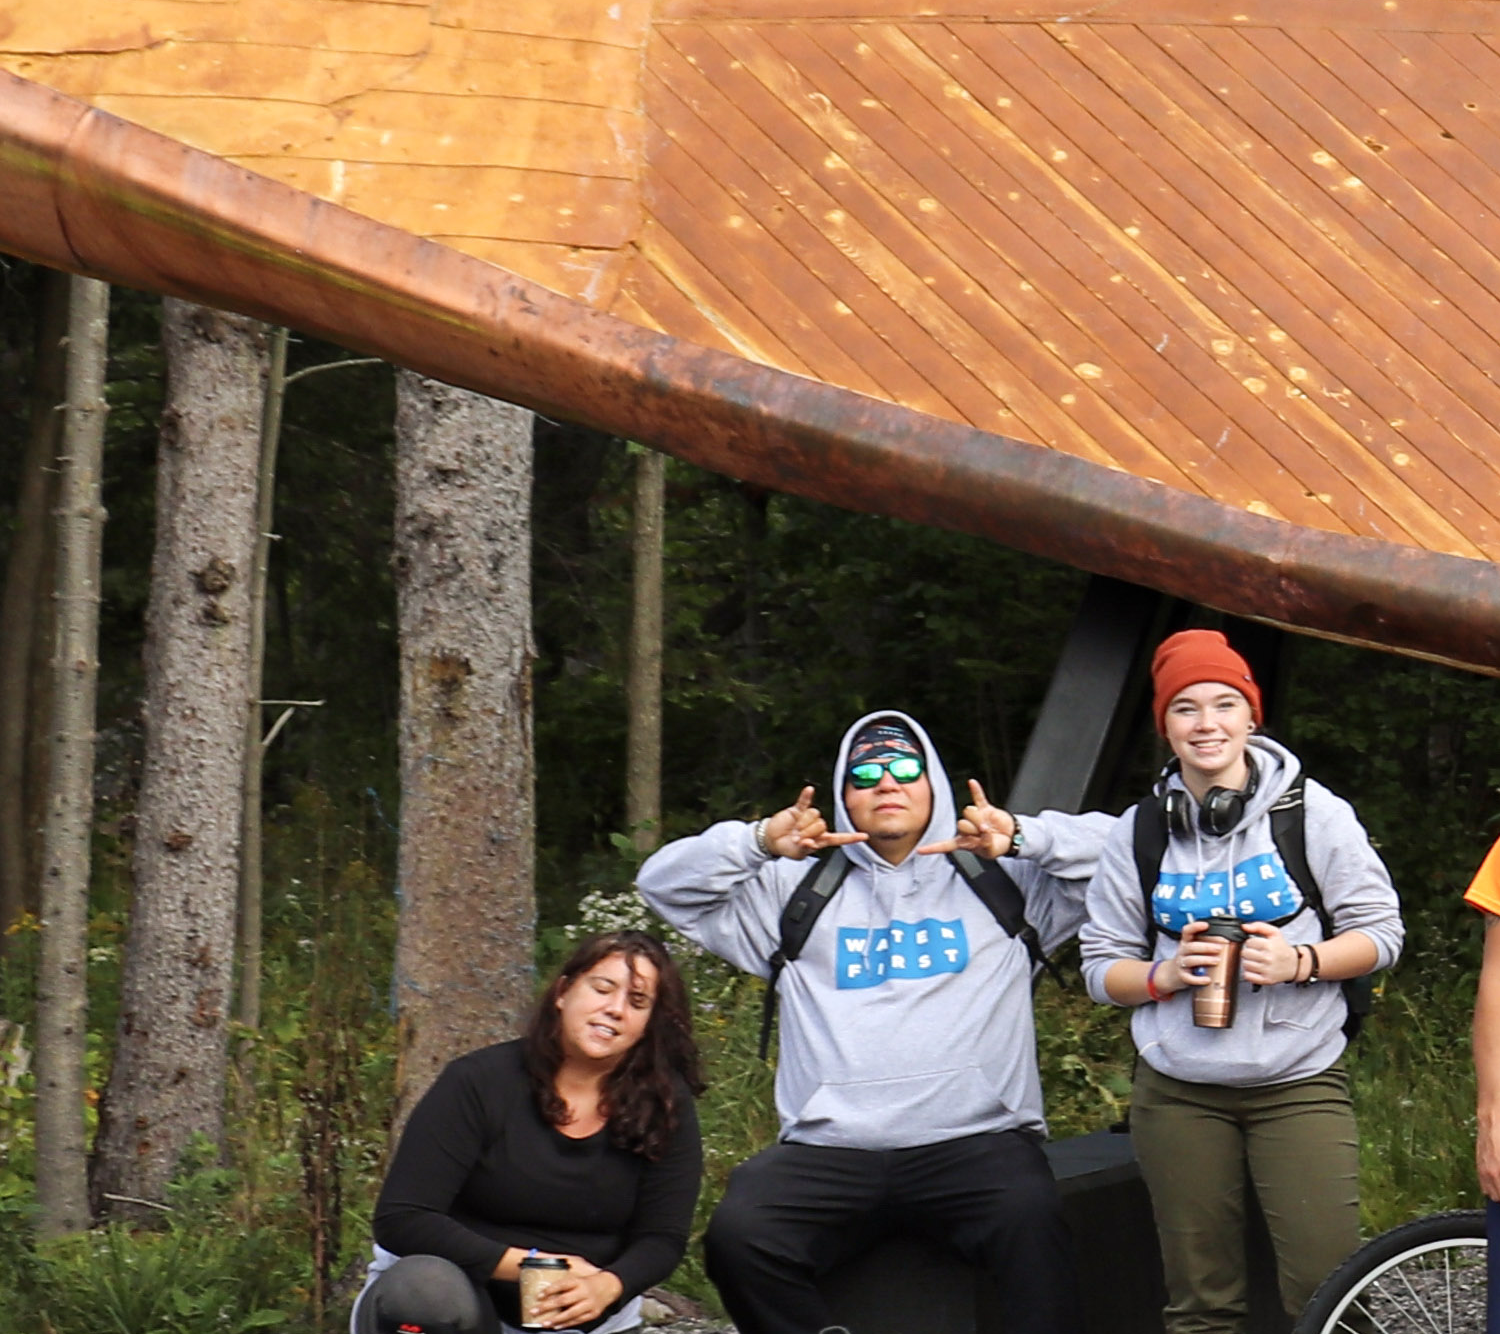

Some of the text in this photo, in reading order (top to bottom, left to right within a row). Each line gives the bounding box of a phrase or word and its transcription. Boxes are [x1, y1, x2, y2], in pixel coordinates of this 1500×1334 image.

[1157, 864, 1276, 900] WATER
[844, 927, 956, 952] WATER
[847, 948, 959, 978] FIRST
